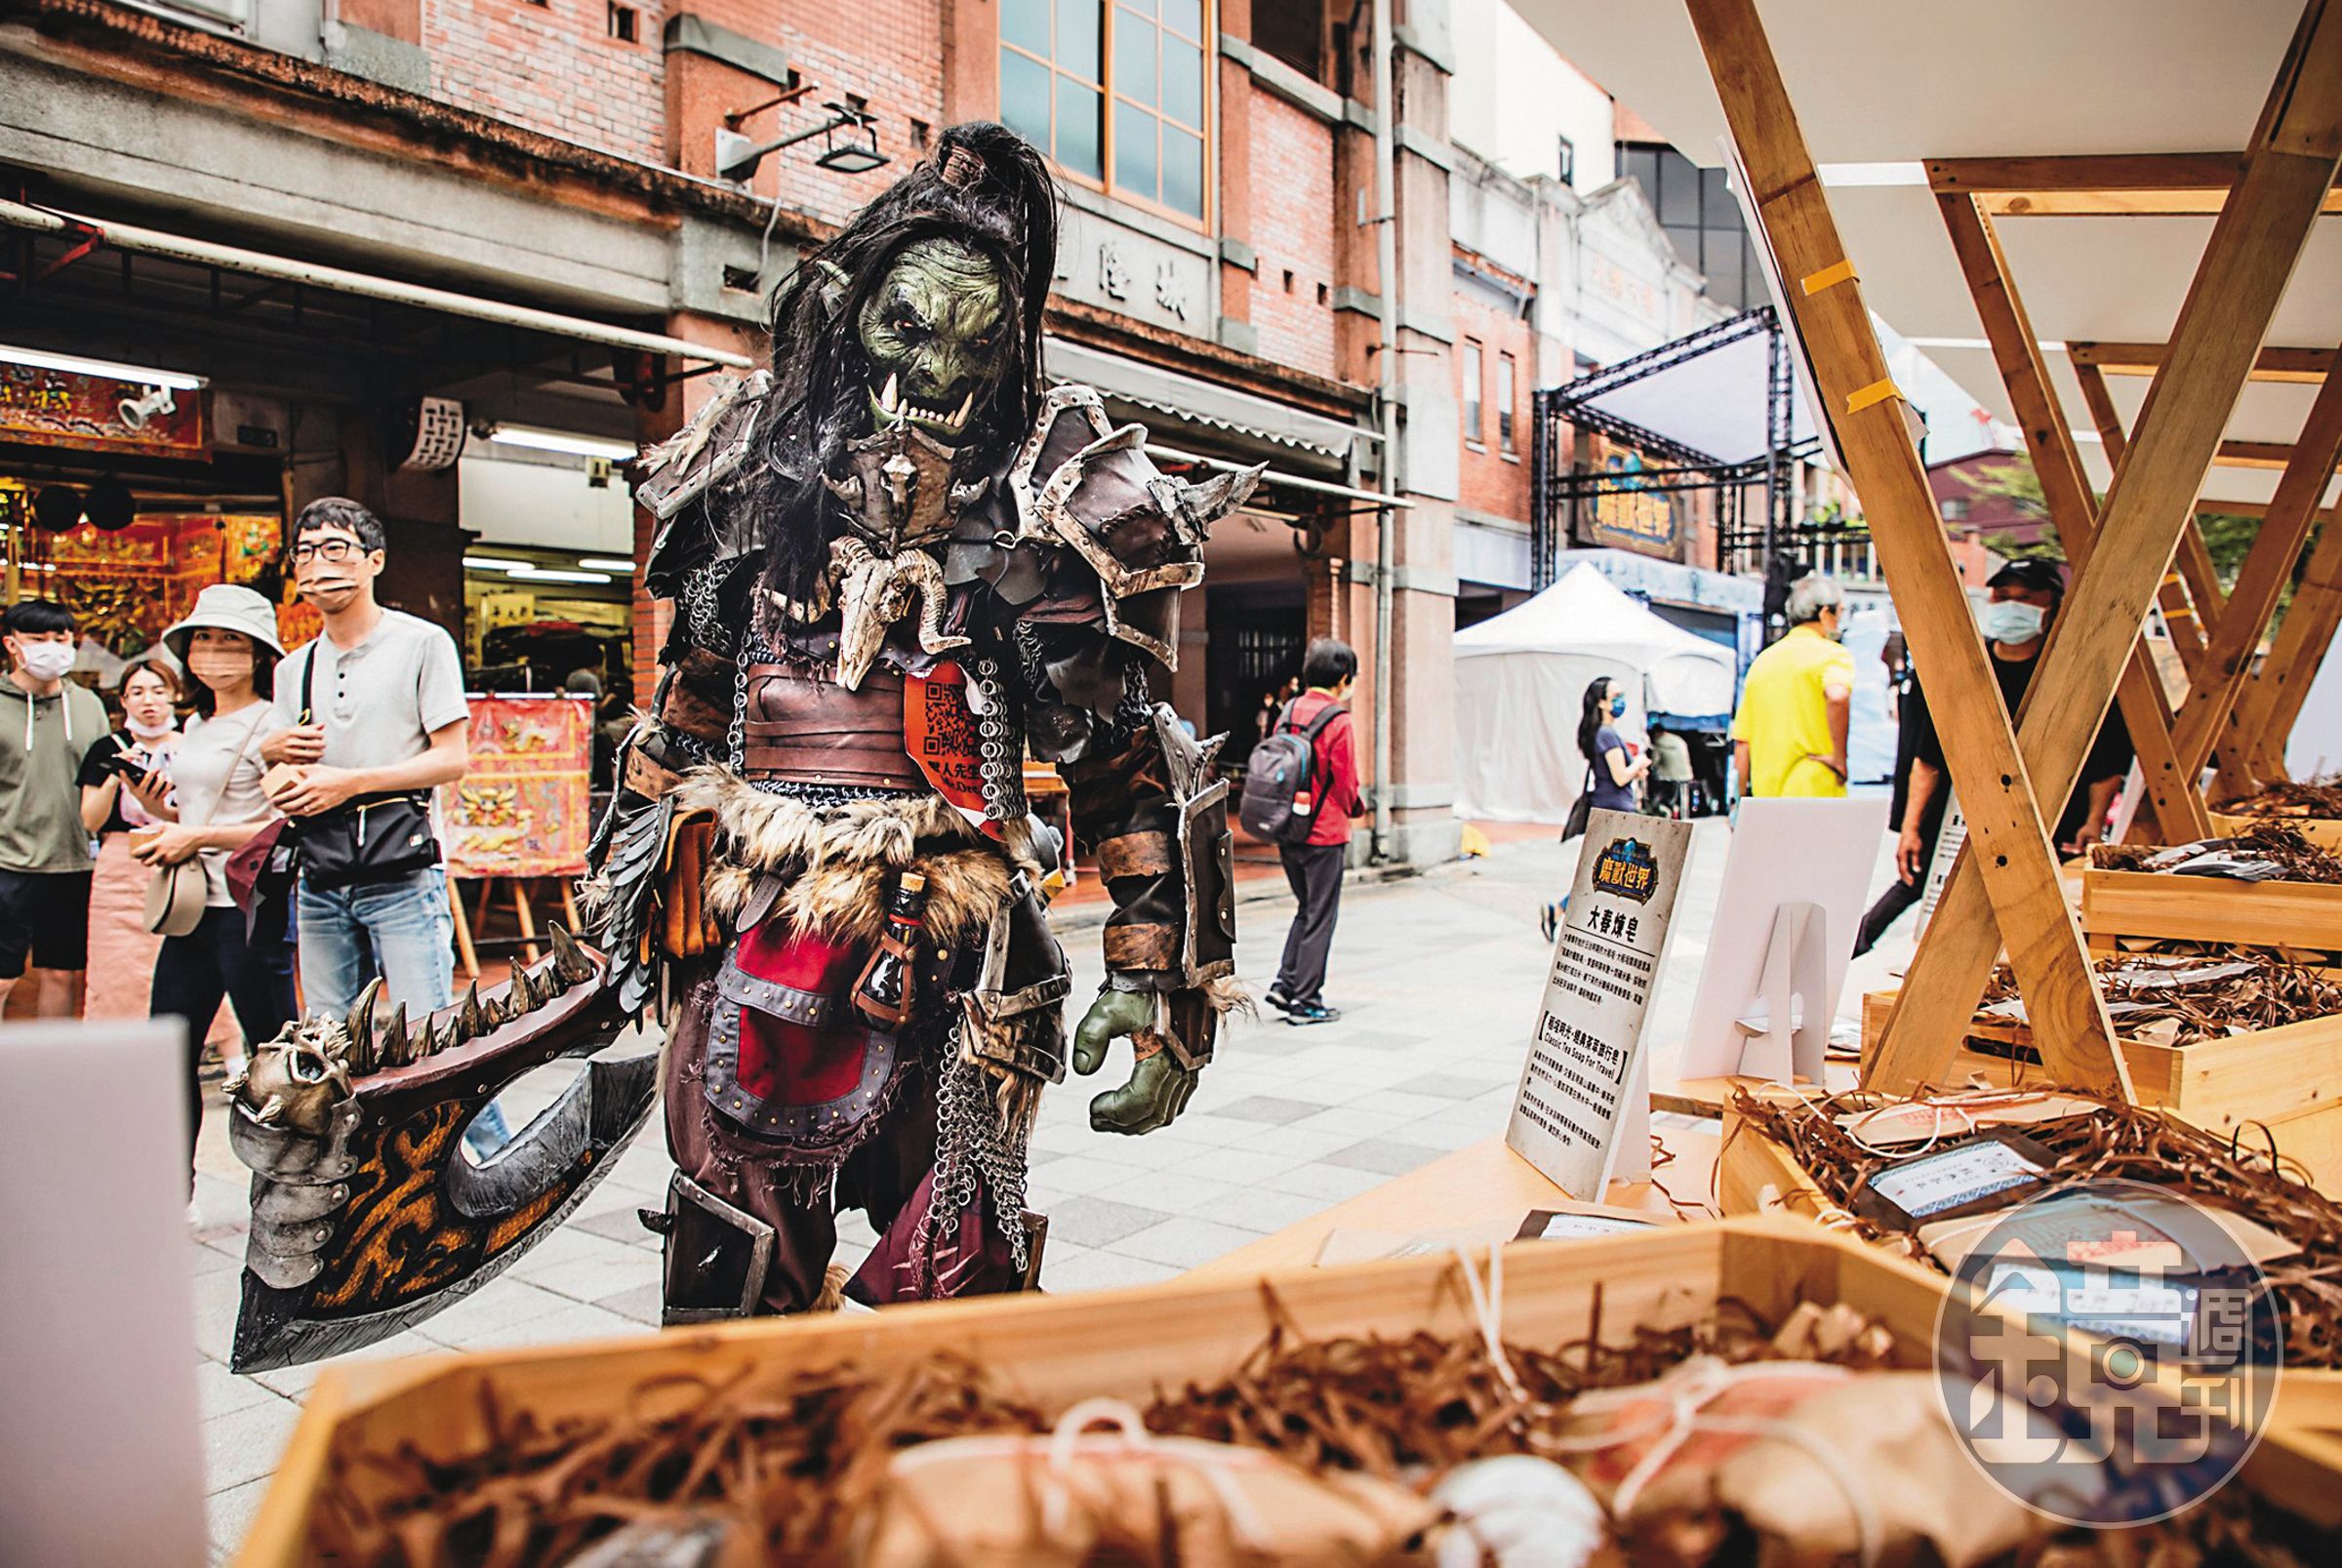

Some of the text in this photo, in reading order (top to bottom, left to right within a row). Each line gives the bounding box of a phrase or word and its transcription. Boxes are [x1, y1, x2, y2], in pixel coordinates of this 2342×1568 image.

[1598, 858, 1651, 890] 魔獸世界
[1588, 905, 1638, 943] 大春煉皂
[1545, 1032, 1561, 1050] Classic
[1596, 1060, 1615, 1079] Travel
